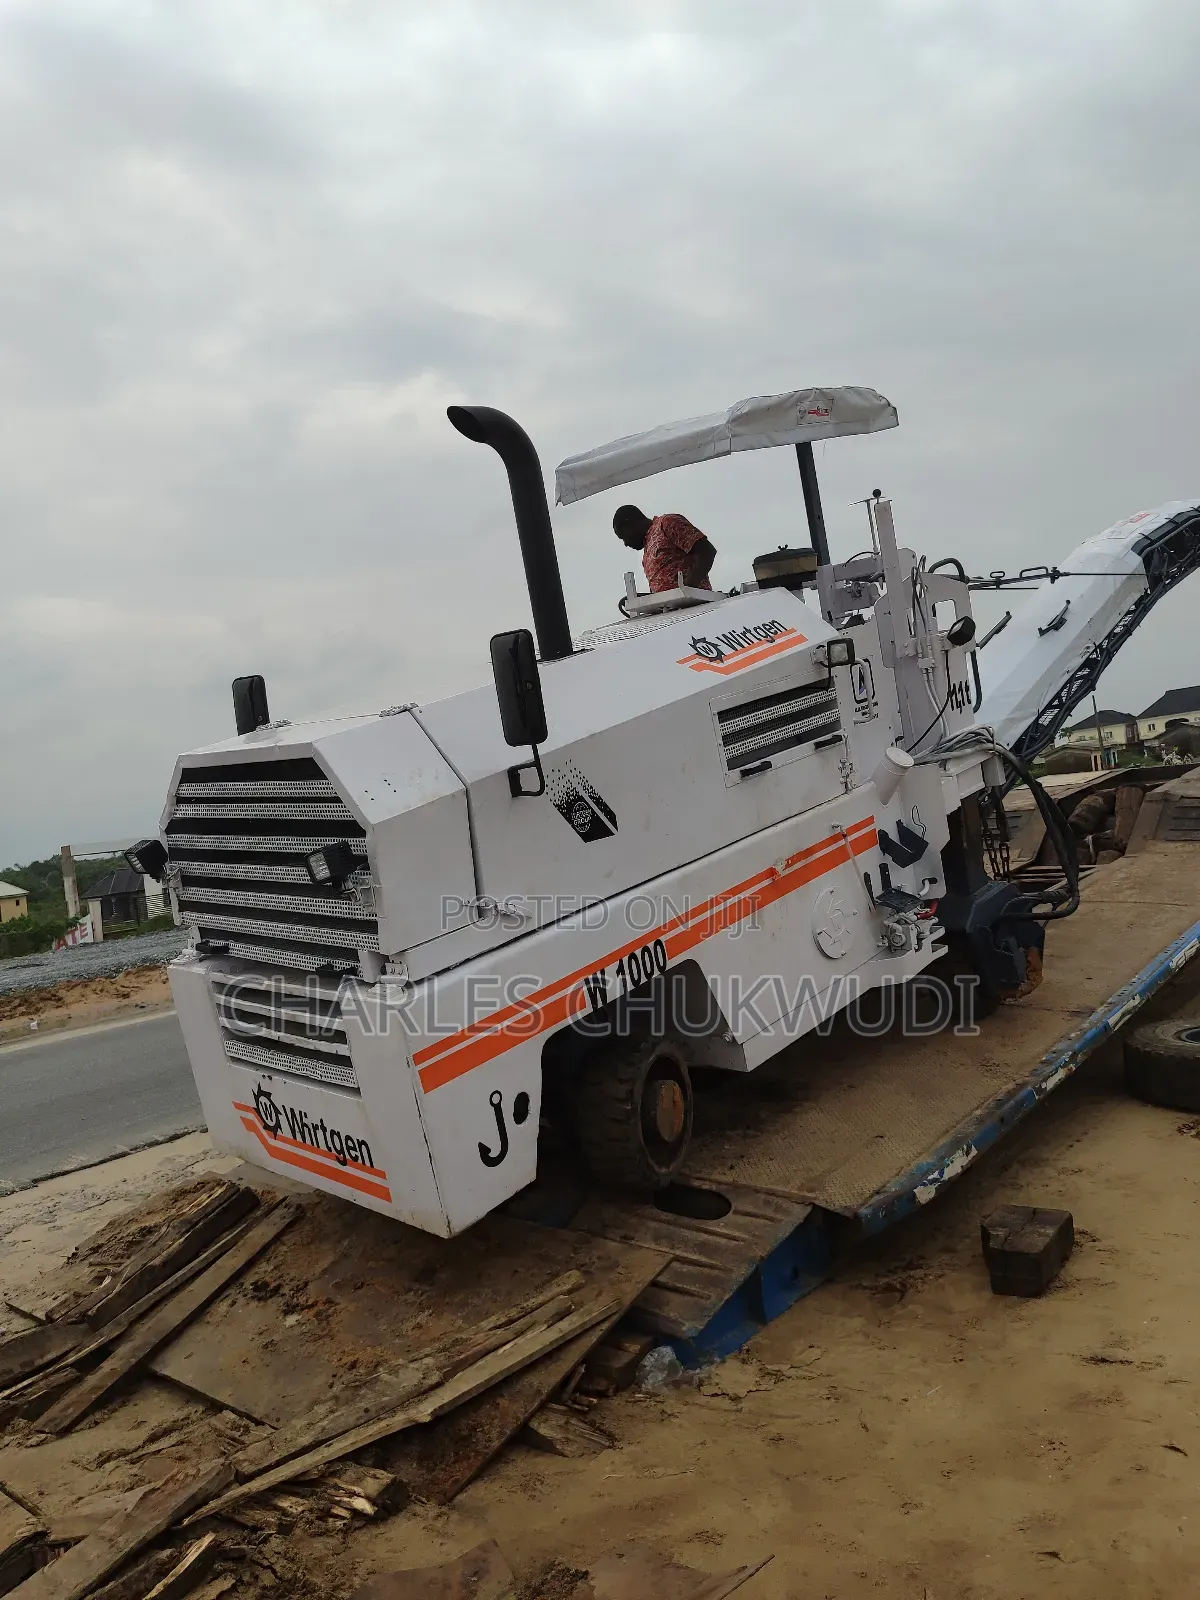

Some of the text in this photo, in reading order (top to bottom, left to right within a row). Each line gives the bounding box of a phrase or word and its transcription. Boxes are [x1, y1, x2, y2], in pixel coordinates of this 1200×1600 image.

[715, 619, 788, 651] Wirtgen
[583, 939, 667, 1012] W 1000
[282, 1104, 375, 1169] Wirtgen
